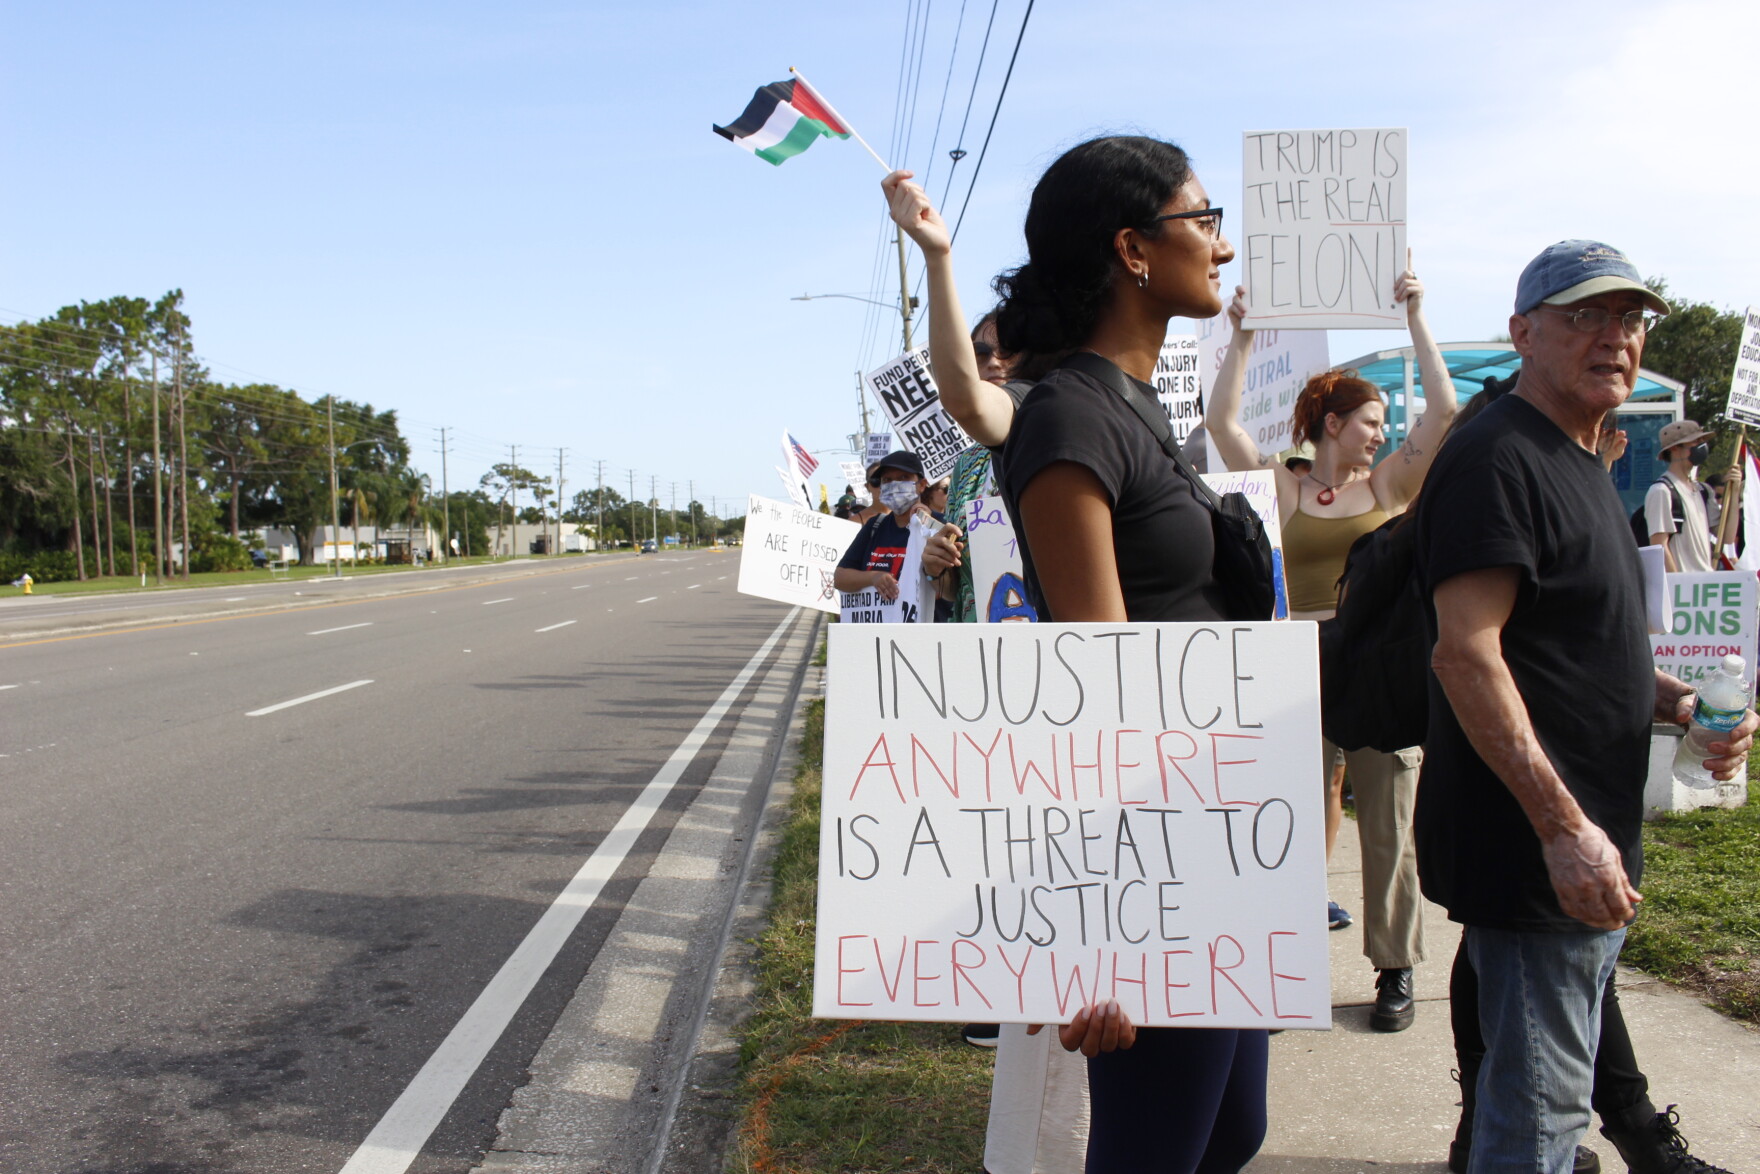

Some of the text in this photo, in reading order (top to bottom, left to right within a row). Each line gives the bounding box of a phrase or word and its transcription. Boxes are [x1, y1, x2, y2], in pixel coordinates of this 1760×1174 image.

[1246, 129, 1400, 179] TRUMP IS
[1247, 177, 1404, 224] THE REAL
[1247, 226, 1398, 312] FELON!
[873, 348, 931, 391] FUND PEOP
[1158, 376, 1195, 394] ONE IS
[880, 363, 939, 418] NEE
[1242, 392, 1272, 422] side
[1162, 401, 1198, 420] NJURY
[904, 413, 943, 449] NOT
[750, 497, 763, 515] We
[792, 508, 822, 529] PEOPLE
[968, 499, 1006, 532] La
[764, 532, 838, 562] ARE PISSED
[780, 563, 809, 587] OFF!
[841, 592, 871, 609] LIBERTAD
[1674, 583, 1742, 607] LIFE
[1654, 645, 1741, 657] AN OPTION
[875, 627, 1264, 730] INJUSTICE
[849, 728, 1265, 806] ANYWHERE
[837, 797, 1295, 884] IS A THREAT TO
[956, 880, 1190, 947] JUSTICE
[837, 931, 1313, 1023] EVERYWHERE
